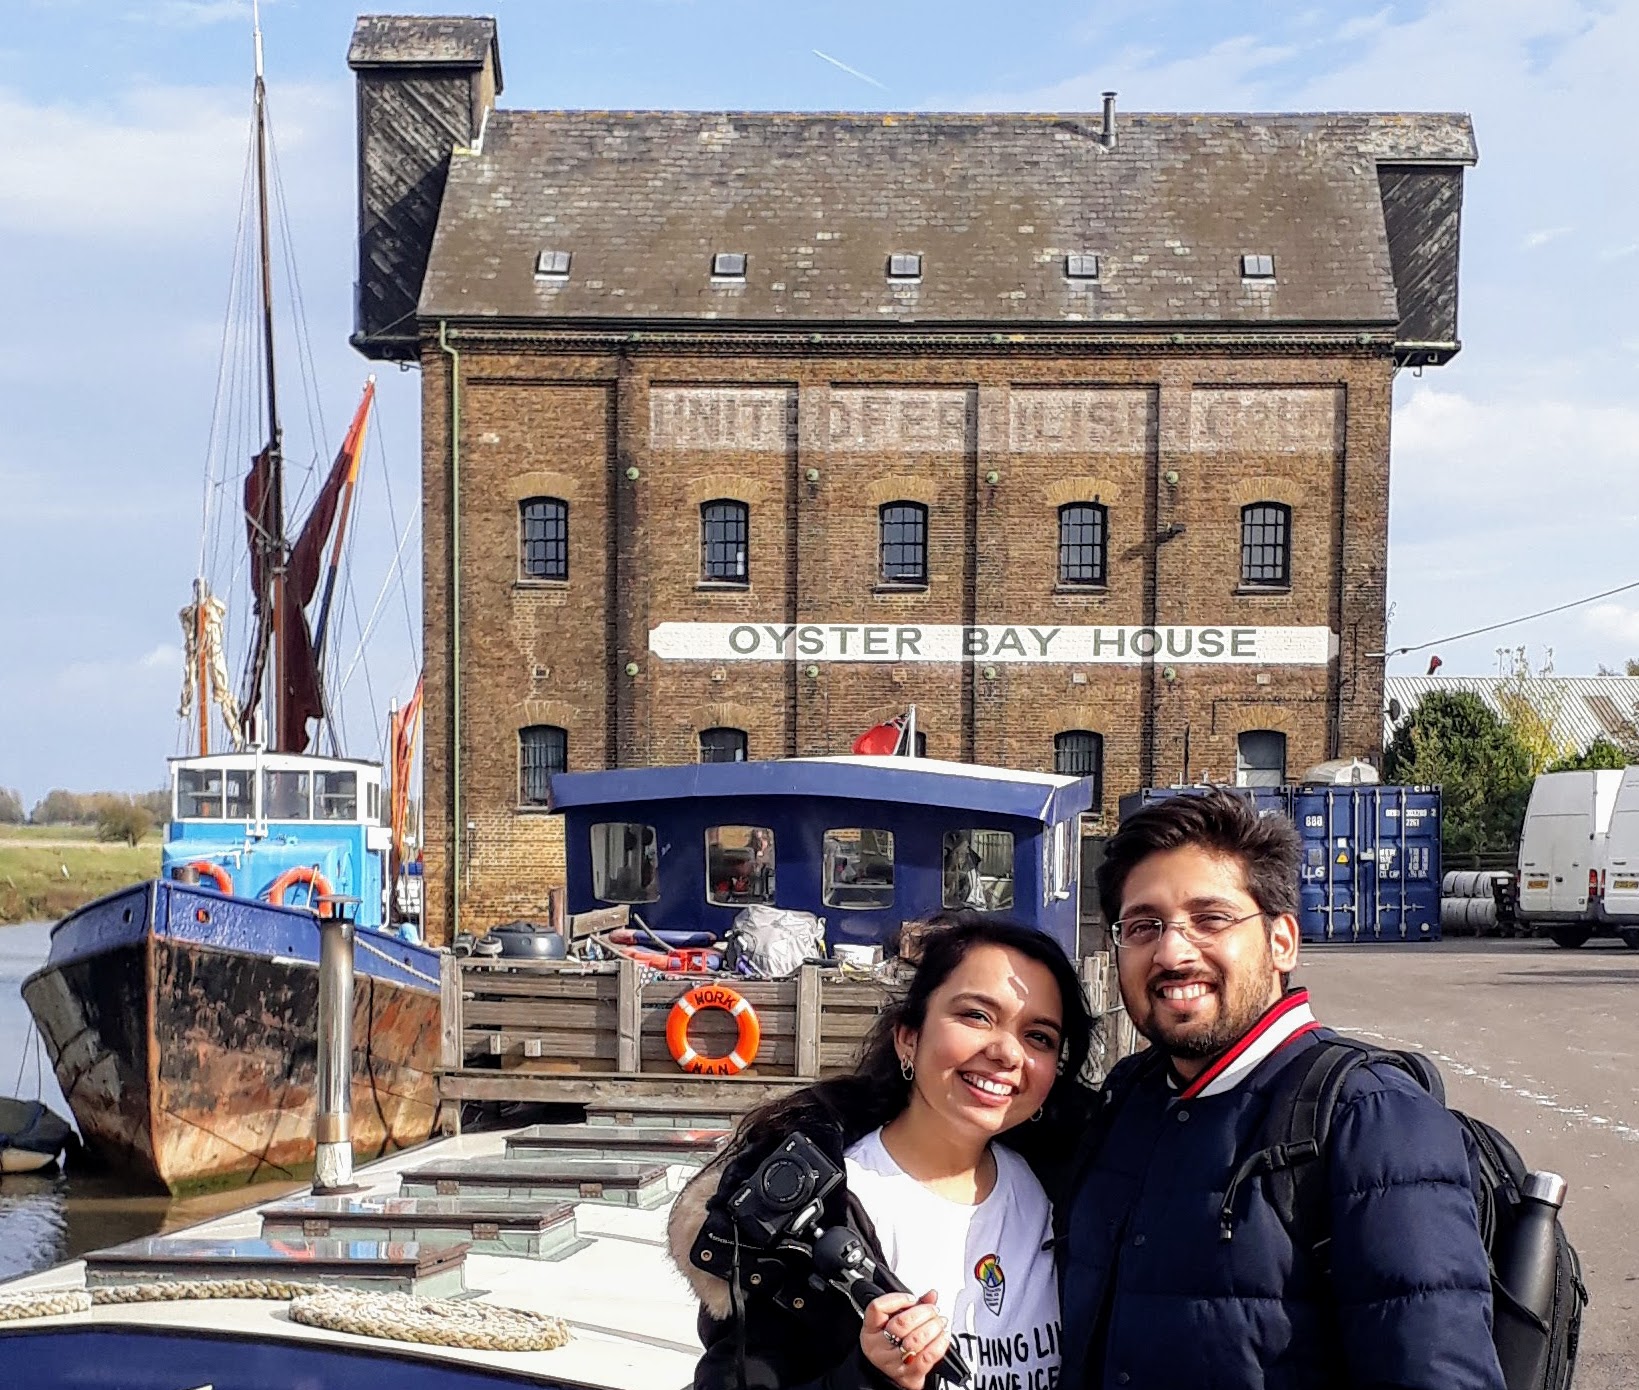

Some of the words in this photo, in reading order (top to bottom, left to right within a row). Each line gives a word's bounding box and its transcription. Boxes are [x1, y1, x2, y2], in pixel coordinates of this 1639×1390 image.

[729, 626, 922, 656] OYSTER
[962, 627, 1062, 656] BAY
[1092, 628, 1257, 657] HOUSE
[695, 991, 737, 1010] WORK
